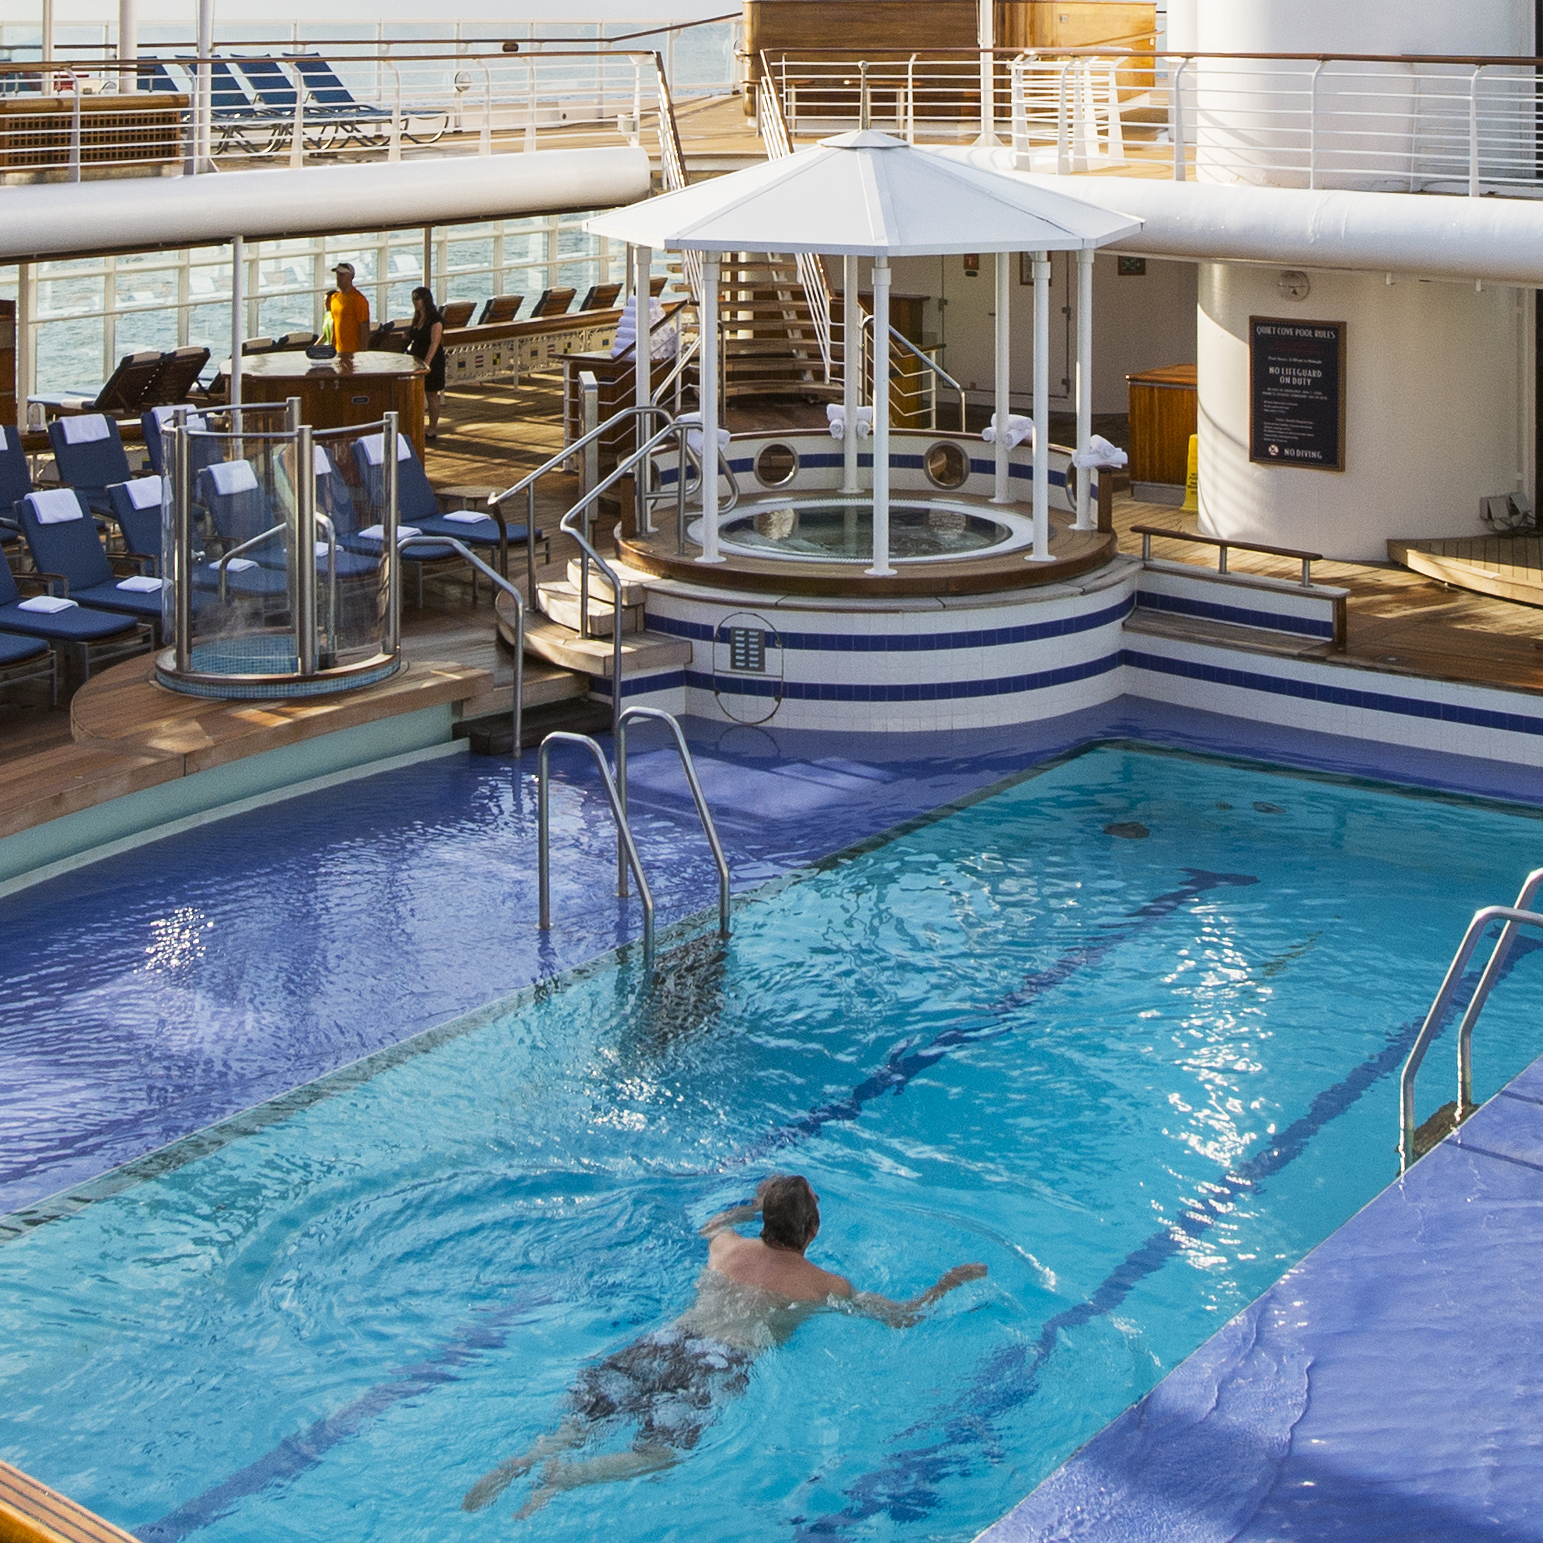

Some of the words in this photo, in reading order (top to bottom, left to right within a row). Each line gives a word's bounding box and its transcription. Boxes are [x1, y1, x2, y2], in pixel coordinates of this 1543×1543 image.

[1256, 326, 1276, 336] QUIET
[1277, 327, 1294, 336] COVE
[1295, 328, 1313, 338] POOL
[1314, 330, 1336, 340] RULES
[1269, 366, 1280, 374] NO
[1281, 367, 1322, 378] LIFEGUARD
[1280, 376, 1290, 384] ON
[1292, 377, 1312, 386] DUTY
[1284, 448, 1295, 457] NO
[1296, 449, 1322, 460] DIVING
